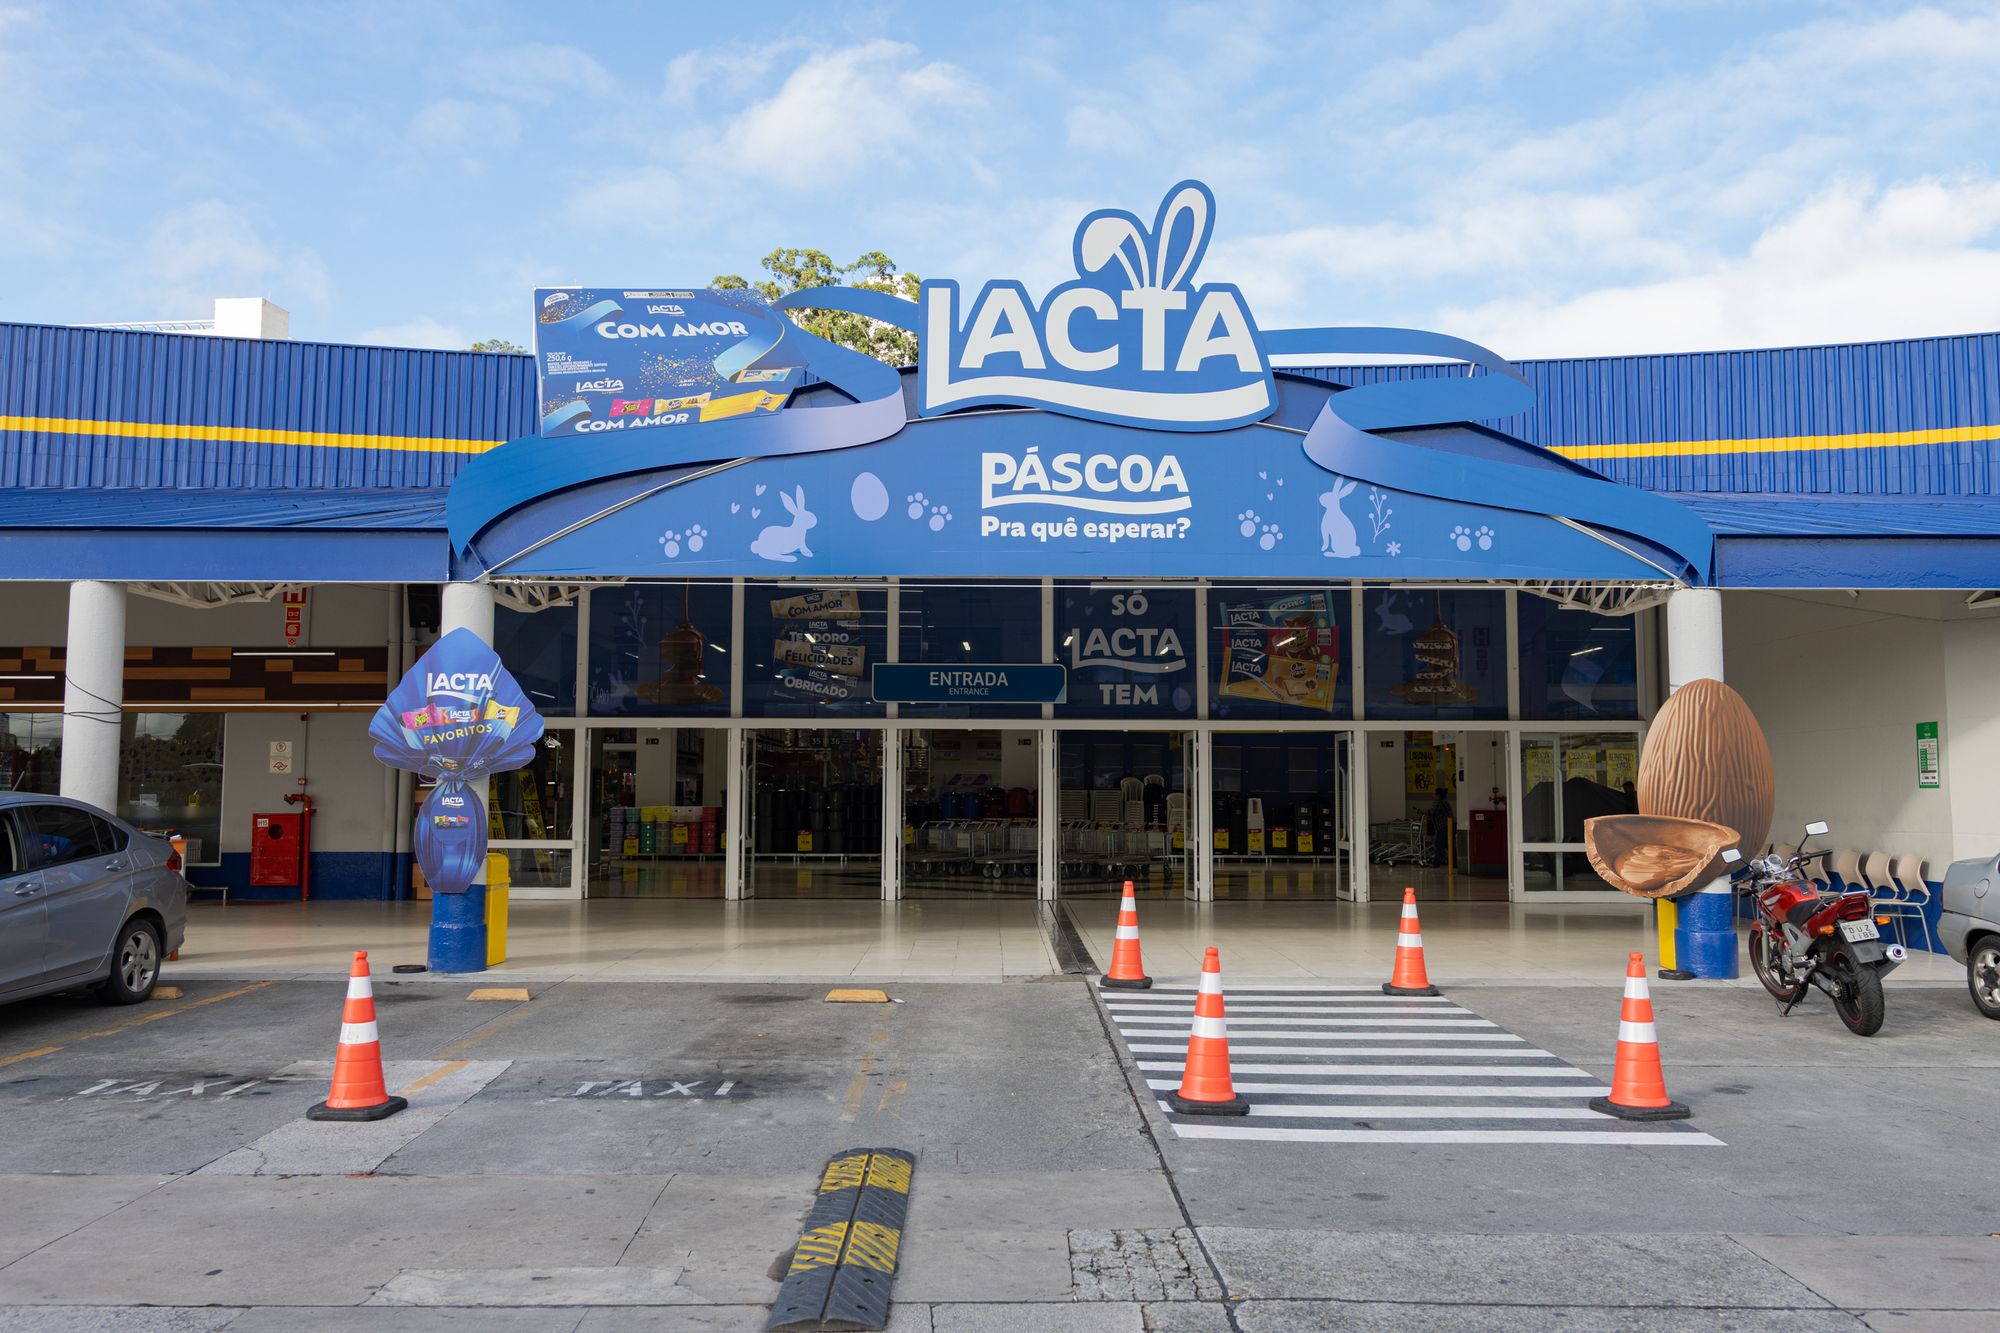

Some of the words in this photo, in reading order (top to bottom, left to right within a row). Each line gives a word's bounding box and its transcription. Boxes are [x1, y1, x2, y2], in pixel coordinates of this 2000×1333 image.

[647, 304, 685, 315] LACTA
[597, 322, 666, 339] COM
[672, 321, 749, 338] AMOR
[926, 286, 1270, 421] LACTA
[576, 379, 625, 393] LACTA
[575, 418, 625, 433] COM
[629, 412, 690, 429] AMOR
[981, 445, 1192, 514] PÁSCOA
[981, 515, 1026, 537] Pra
[1031, 516, 1077, 543] quê
[1083, 516, 1192, 543] esperar?
[788, 606, 811, 617] COM
[813, 599, 843, 613] AMOR
[1111, 590, 1148, 616] SÓ
[1279, 599, 1305, 611] OREO
[809, 621, 828, 630] LACTA
[1230, 611, 1261, 625] LACTA
[805, 632, 850, 643] DORO
[1231, 638, 1262, 650] LACTA
[785, 650, 854, 666] FELICIDADES
[1071, 628, 1187, 673] LACTA
[809, 669, 828, 680] LACTA
[1231, 661, 1262, 673] LACTA
[929, 671, 1009, 686] ENTRADA
[427, 673, 494, 703] LACTA
[784, 676, 848, 698] OBRIGADO
[949, 687, 990, 696] ENTRANCE
[1099, 684, 1159, 705] TEM
[450, 710, 471, 719] LACTA
[423, 723, 493, 745] FAVORITOS
[442, 796, 465, 806] LACTA
[1848, 924, 1870, 934] DUZ
[1852, 930, 1875, 940] 1186
[72, 1079, 261, 1097] TAXI
[574, 1080, 737, 1097] TAXI
